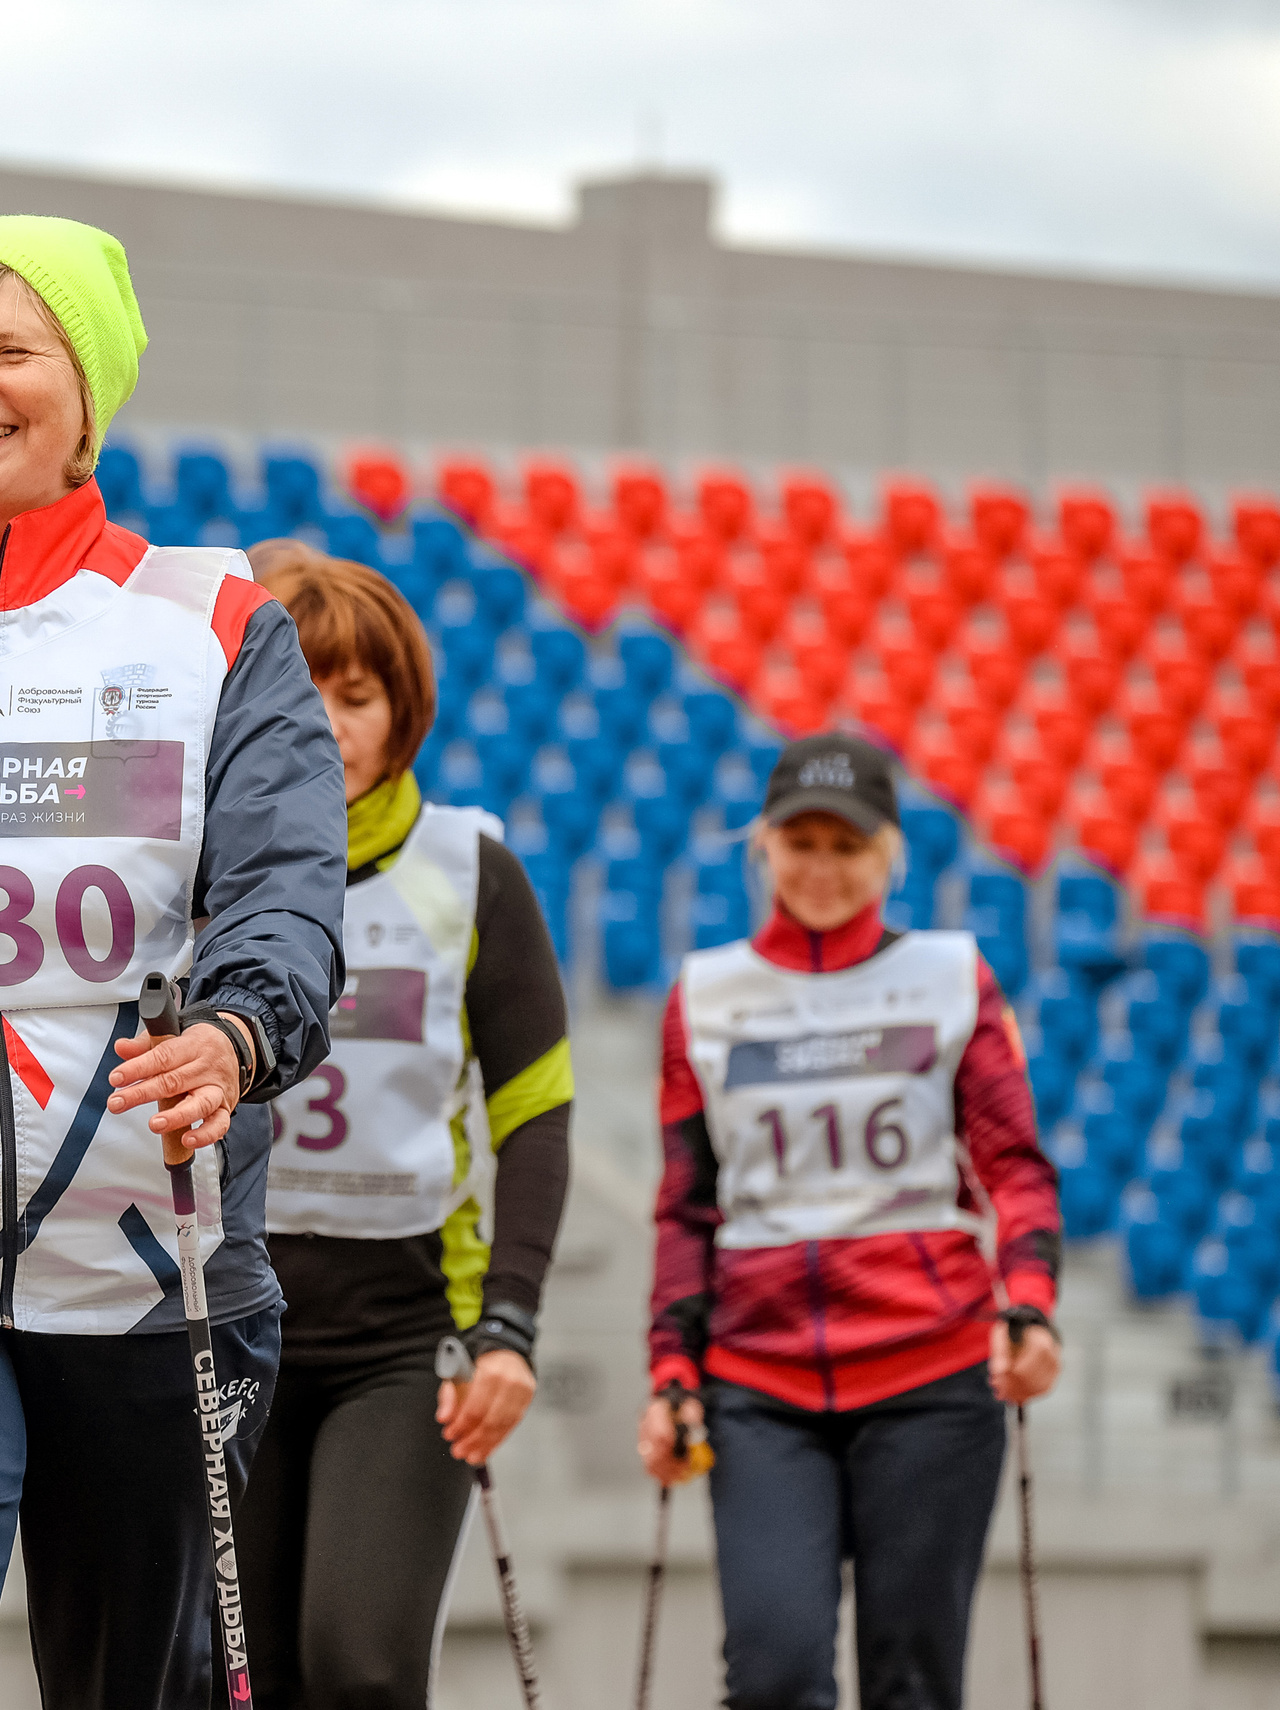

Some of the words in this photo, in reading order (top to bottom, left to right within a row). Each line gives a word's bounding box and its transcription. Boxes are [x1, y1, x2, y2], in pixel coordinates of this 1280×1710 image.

[18, 687, 83, 697] Добровольный
[17, 697, 82, 706] Физкультурный
[17, 706, 41, 714] Союз
[31, 811, 85, 823] ЖИЗНИ
[273, 1063, 347, 1150] 3
[758, 1099, 908, 1178] 116
[194, 1350, 232, 1518] СЕВЕРНАЯ
